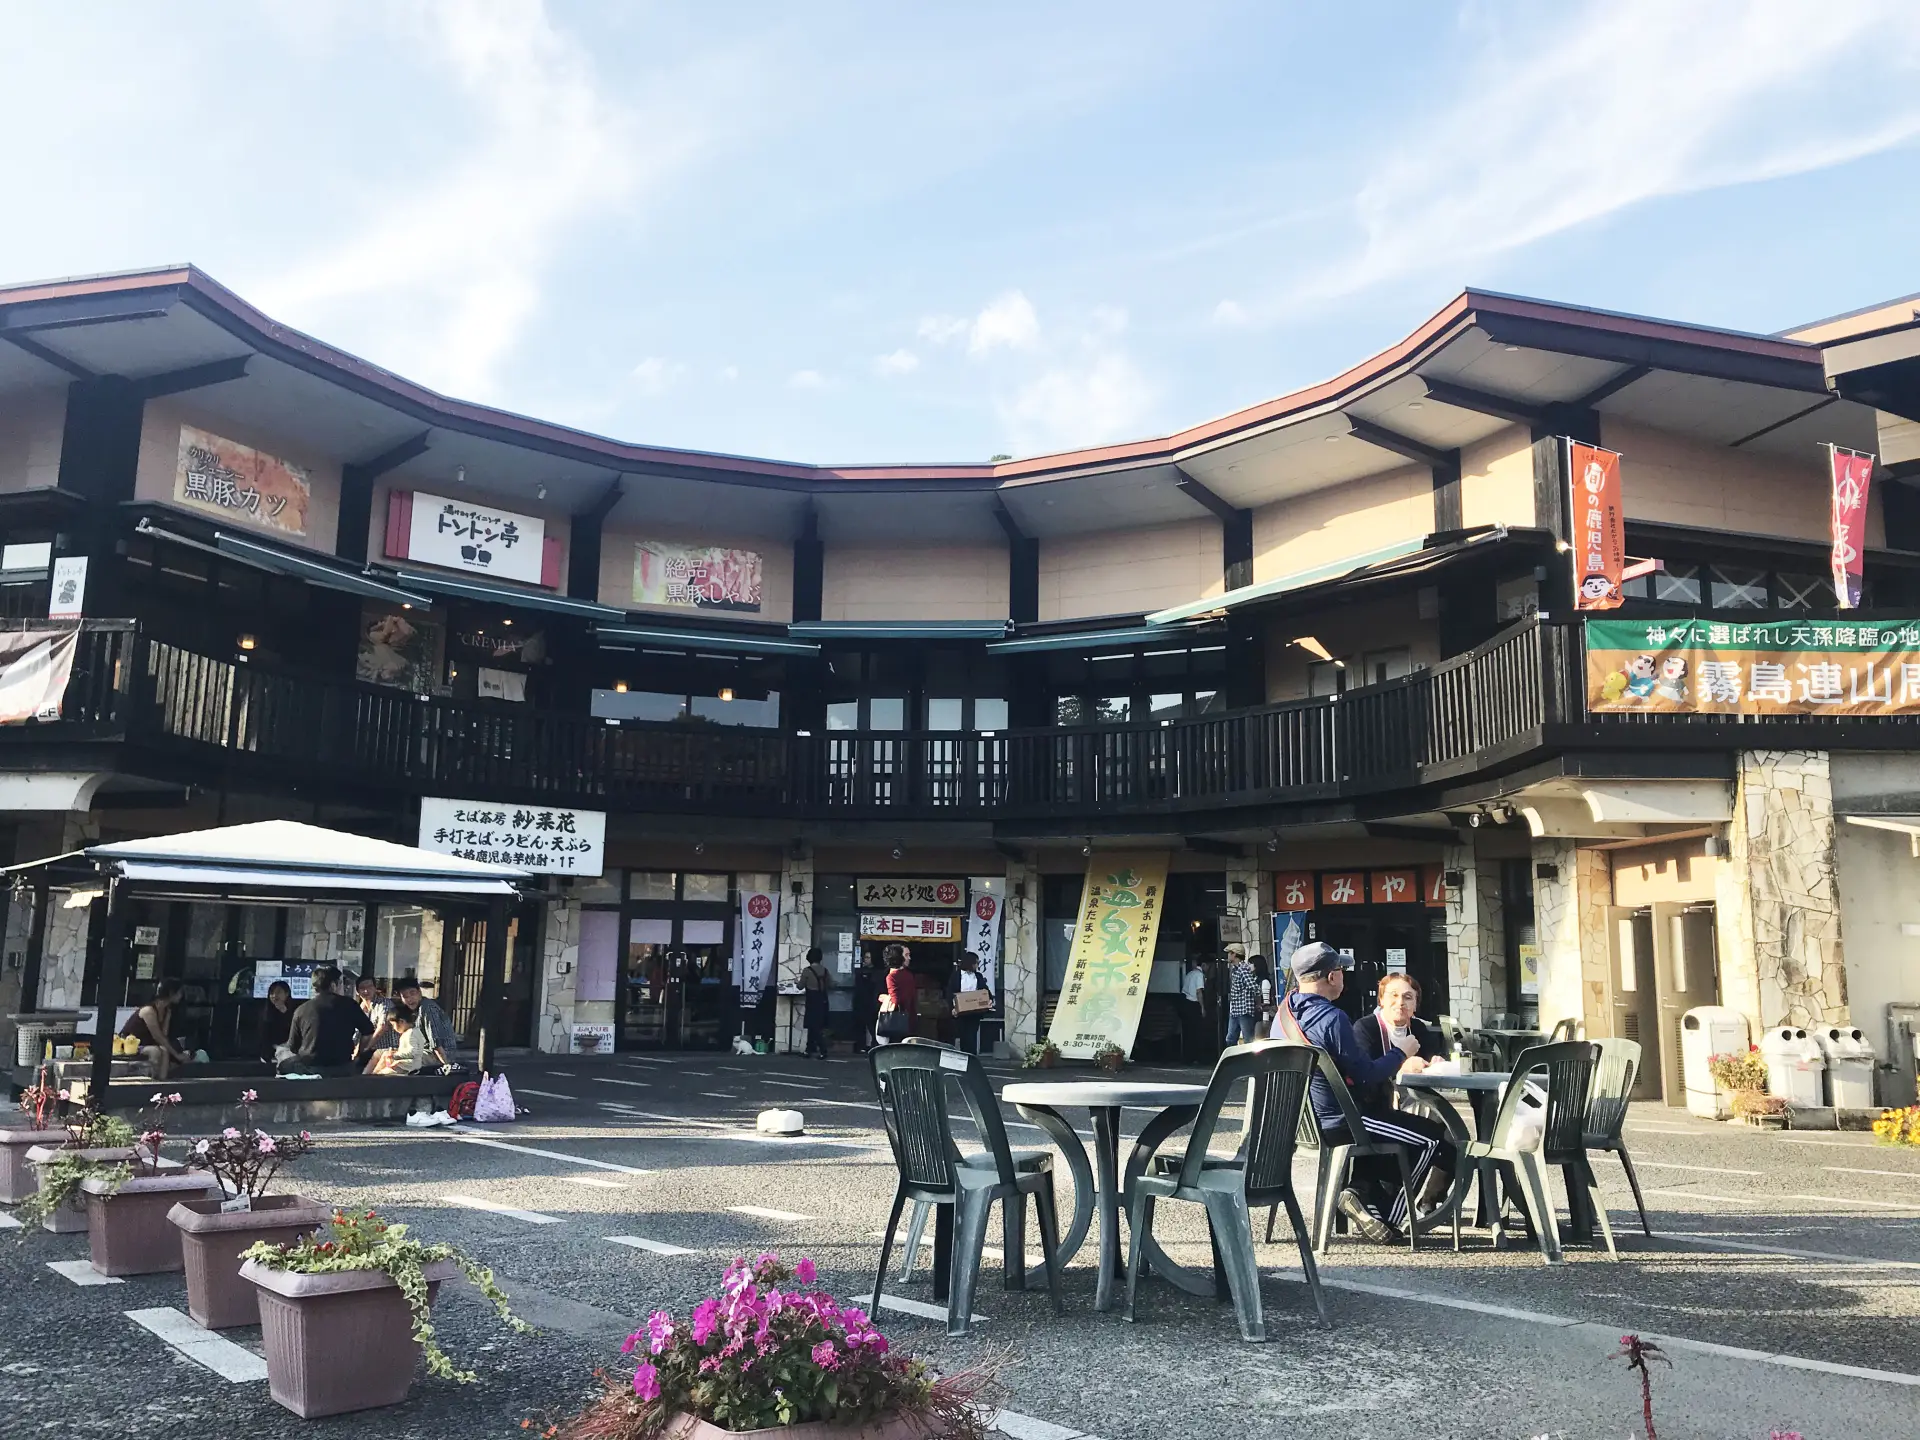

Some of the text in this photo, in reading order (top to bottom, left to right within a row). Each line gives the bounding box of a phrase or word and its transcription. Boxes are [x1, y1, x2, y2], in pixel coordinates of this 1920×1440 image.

[184, 471, 287, 517] 黒豚カツ
[438, 513, 520, 549] トントン亭
[665, 557, 707, 578] 絶品
[667, 583, 761, 604] 黒豚しゃぶ
[1646, 624, 1920, 648] 神々に選ばれし天孫降臨の地
[453, 809, 507, 826] そば茶房
[863, 883, 936, 903] みやげ処
[876, 918, 949, 935] 本日一割引
[748, 920, 765, 991] みやげ処
